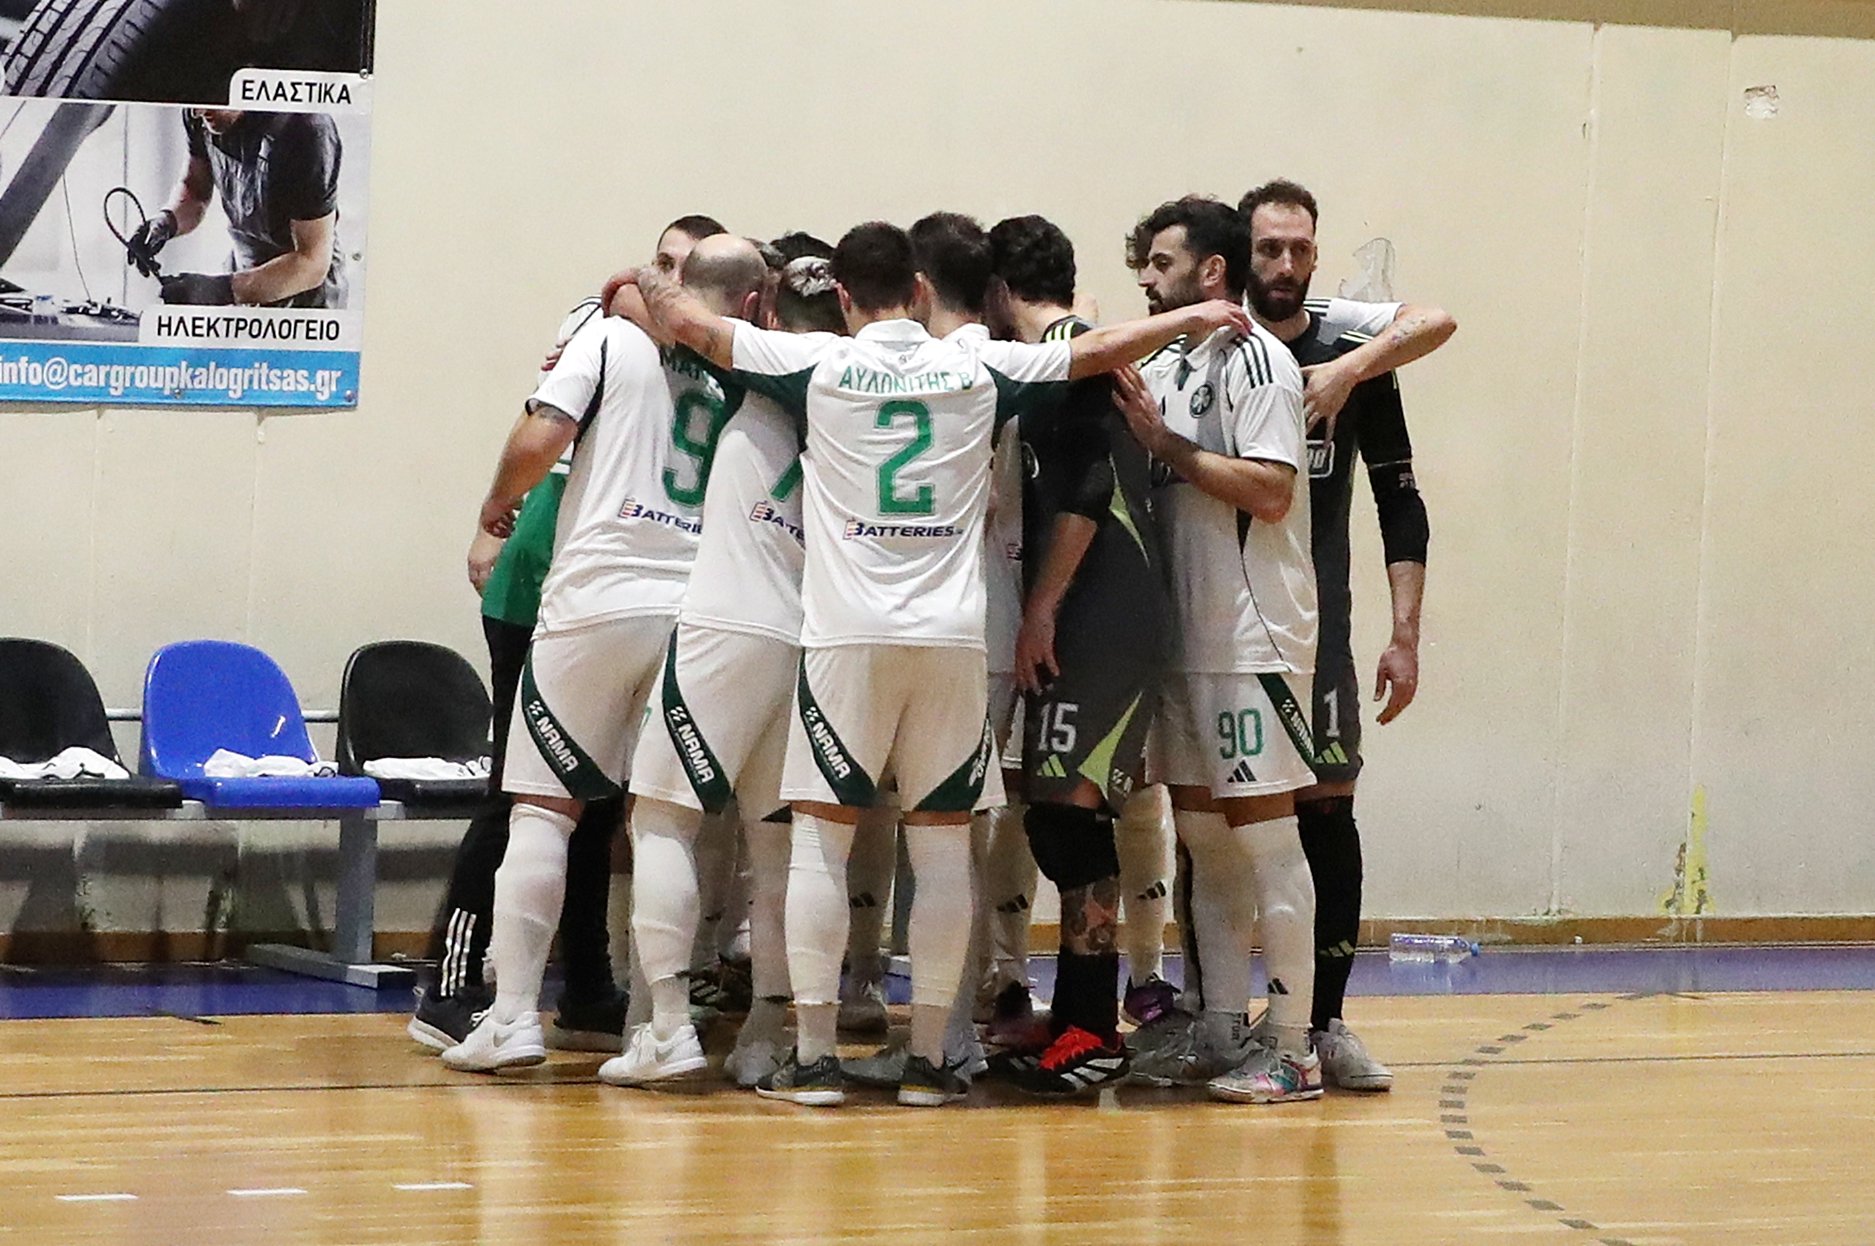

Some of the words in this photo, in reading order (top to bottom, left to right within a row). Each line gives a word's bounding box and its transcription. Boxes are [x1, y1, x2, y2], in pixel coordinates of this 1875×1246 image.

[241, 79, 352, 105] ΕΛΑΣΤΙΚΑ
[157, 315, 340, 341] ΗΛΕΚΤΡΟΛΟΓΕΙΟ
[0, 355, 342, 400] info@cargroupkalogritsas.gr
[661, 388, 726, 508] 9
[875, 399, 935, 516] 2
[843, 517, 954, 540] BATTERIES
[1037, 702, 1079, 752] 15
[1217, 708, 1264, 759] 90
[1323, 690, 1341, 738] 1
[536, 716, 579, 772] NAMA
[678, 723, 725, 784] NAMA
[812, 721, 851, 780] NAMA
